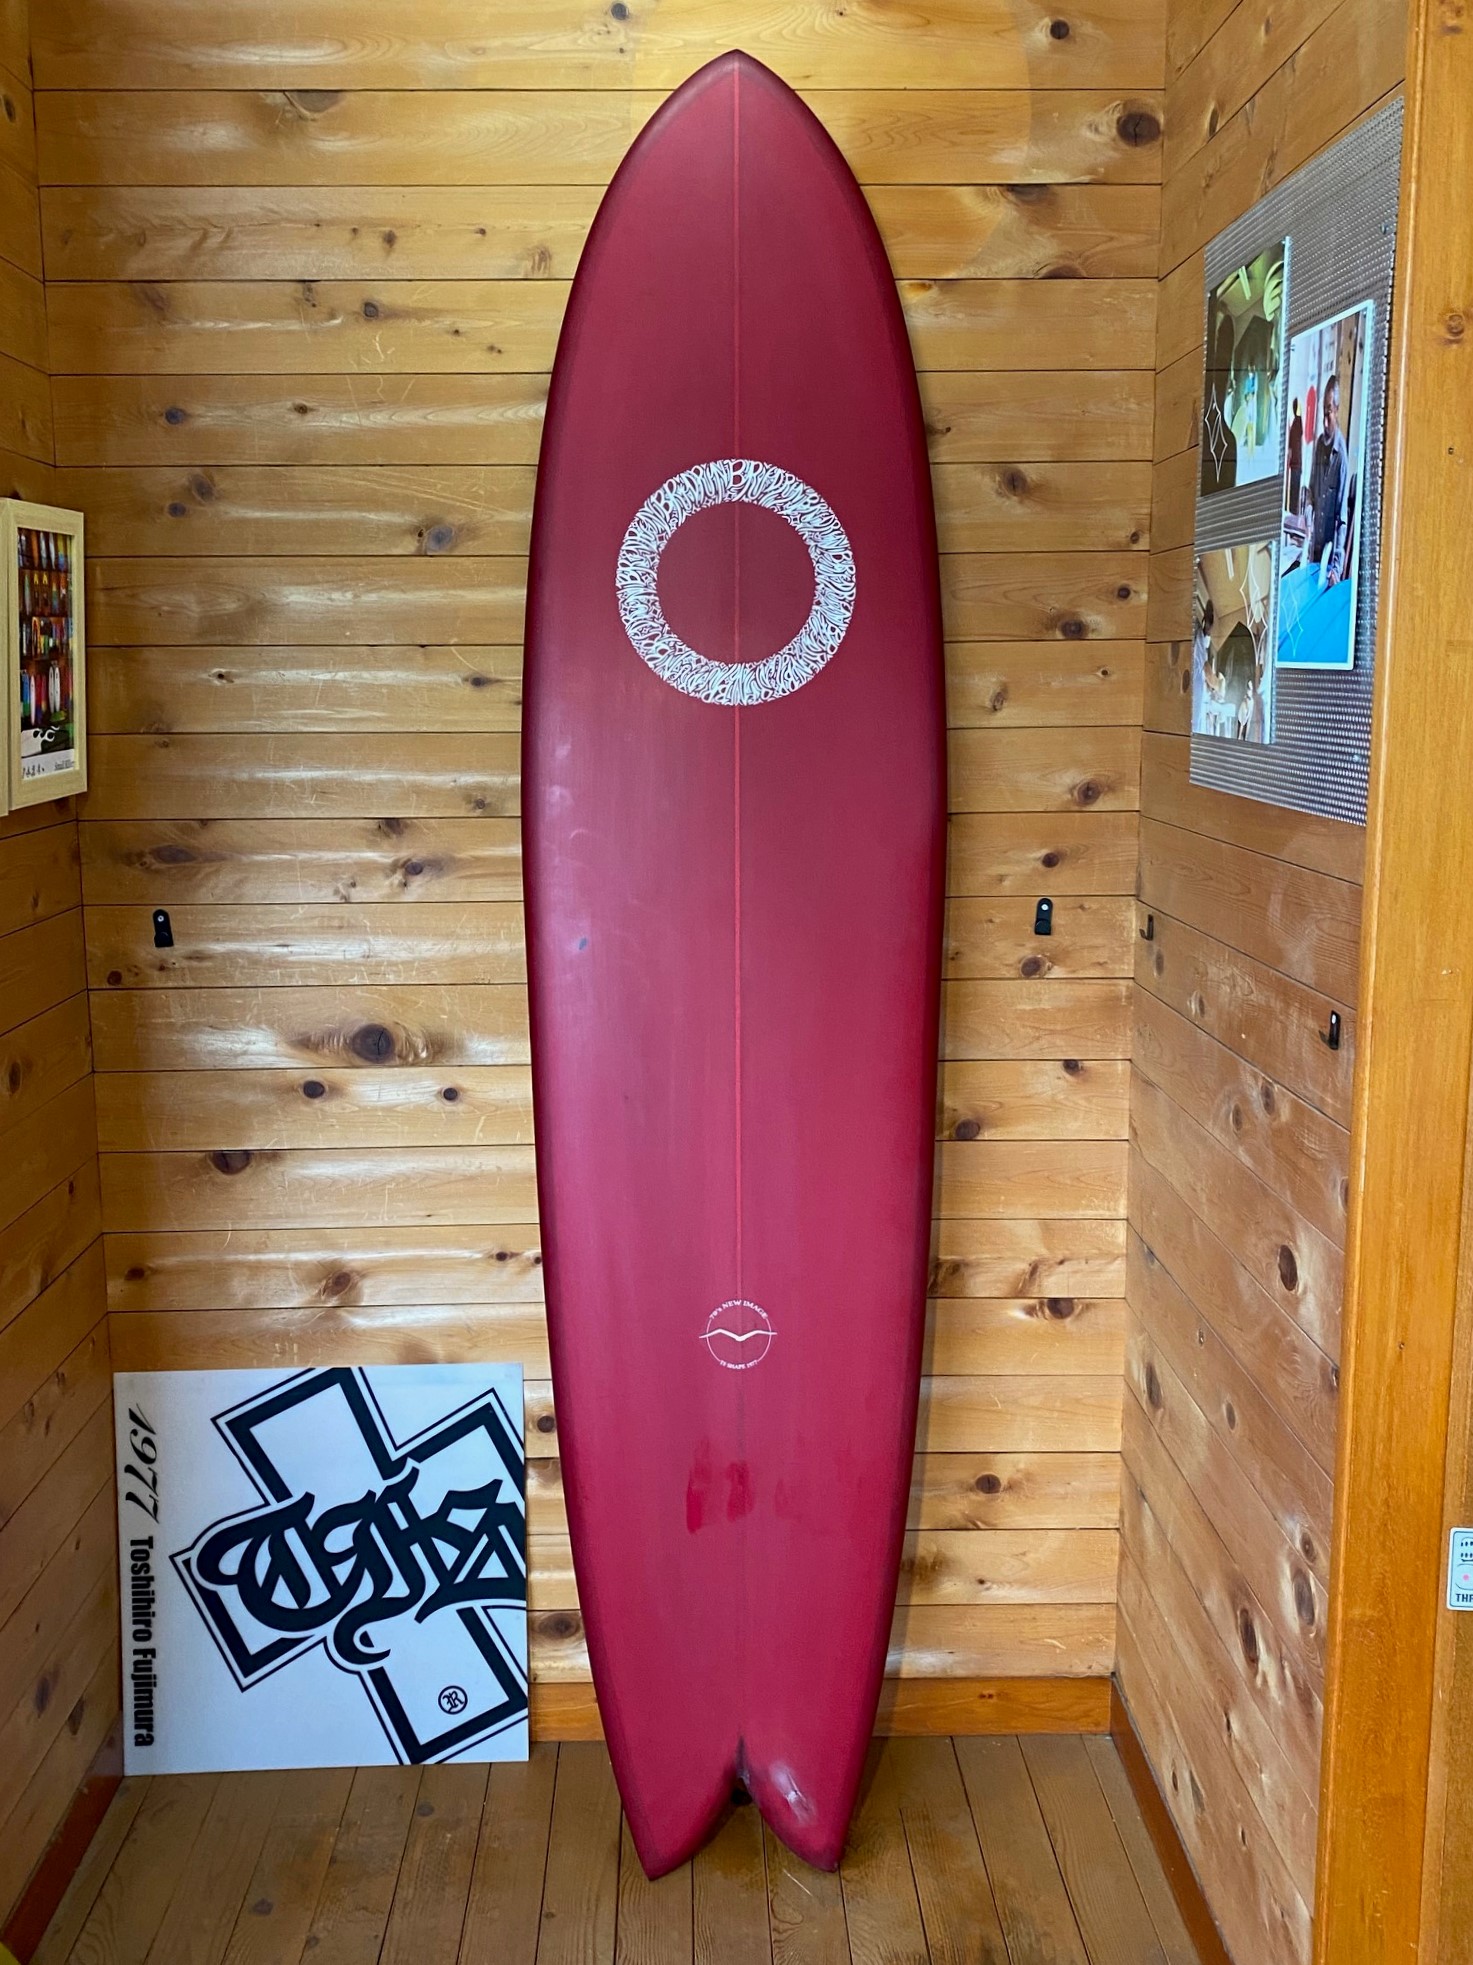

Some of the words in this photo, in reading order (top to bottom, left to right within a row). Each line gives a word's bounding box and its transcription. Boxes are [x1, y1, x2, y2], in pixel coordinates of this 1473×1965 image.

[722, 1300, 741, 1309] NEW
[743, 1300, 768, 1319] IMAGE
[124, 1403, 160, 1523] 1977
[130, 1535, 155, 1643] Toshihiro
[132, 1648, 157, 1747] Fujimura
